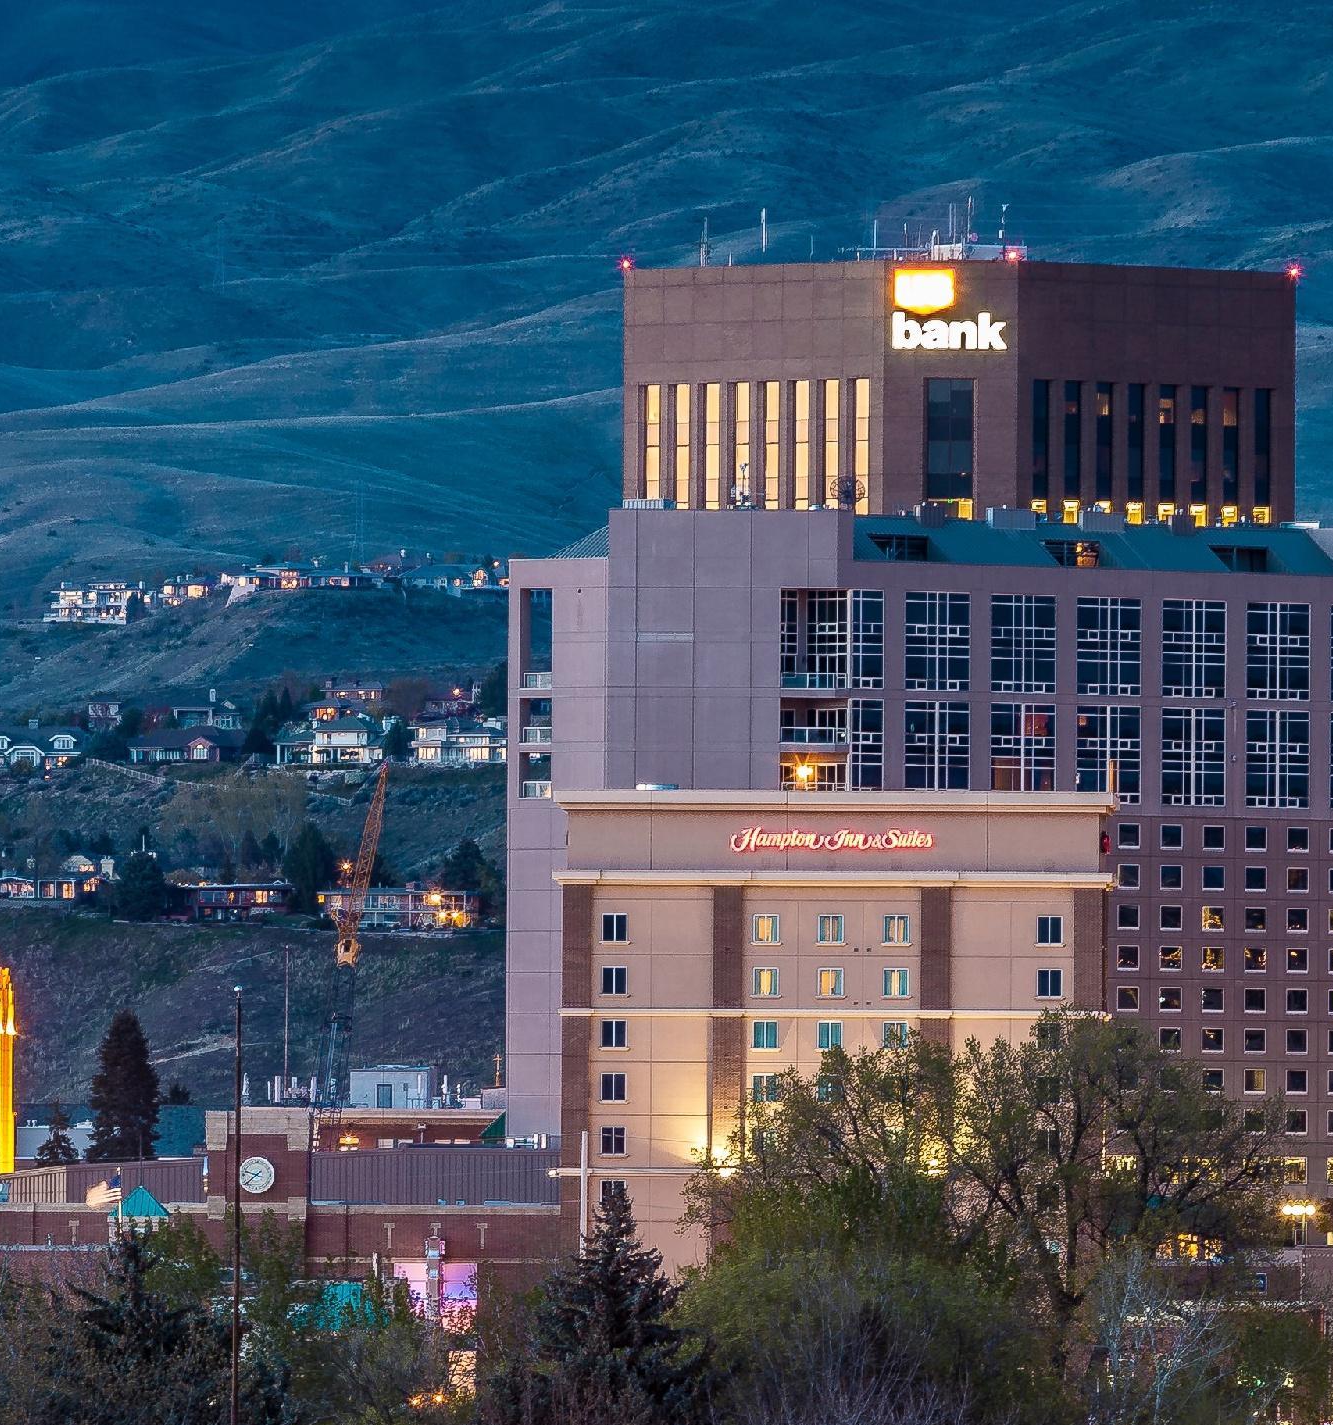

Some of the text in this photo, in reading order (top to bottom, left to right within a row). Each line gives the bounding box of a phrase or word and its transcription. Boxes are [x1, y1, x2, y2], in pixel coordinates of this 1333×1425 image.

[891, 311, 1008, 351] bank
[730, 826, 822, 851] Hampton
[824, 828, 872, 850] Inn
[881, 828, 934, 849] Suites
